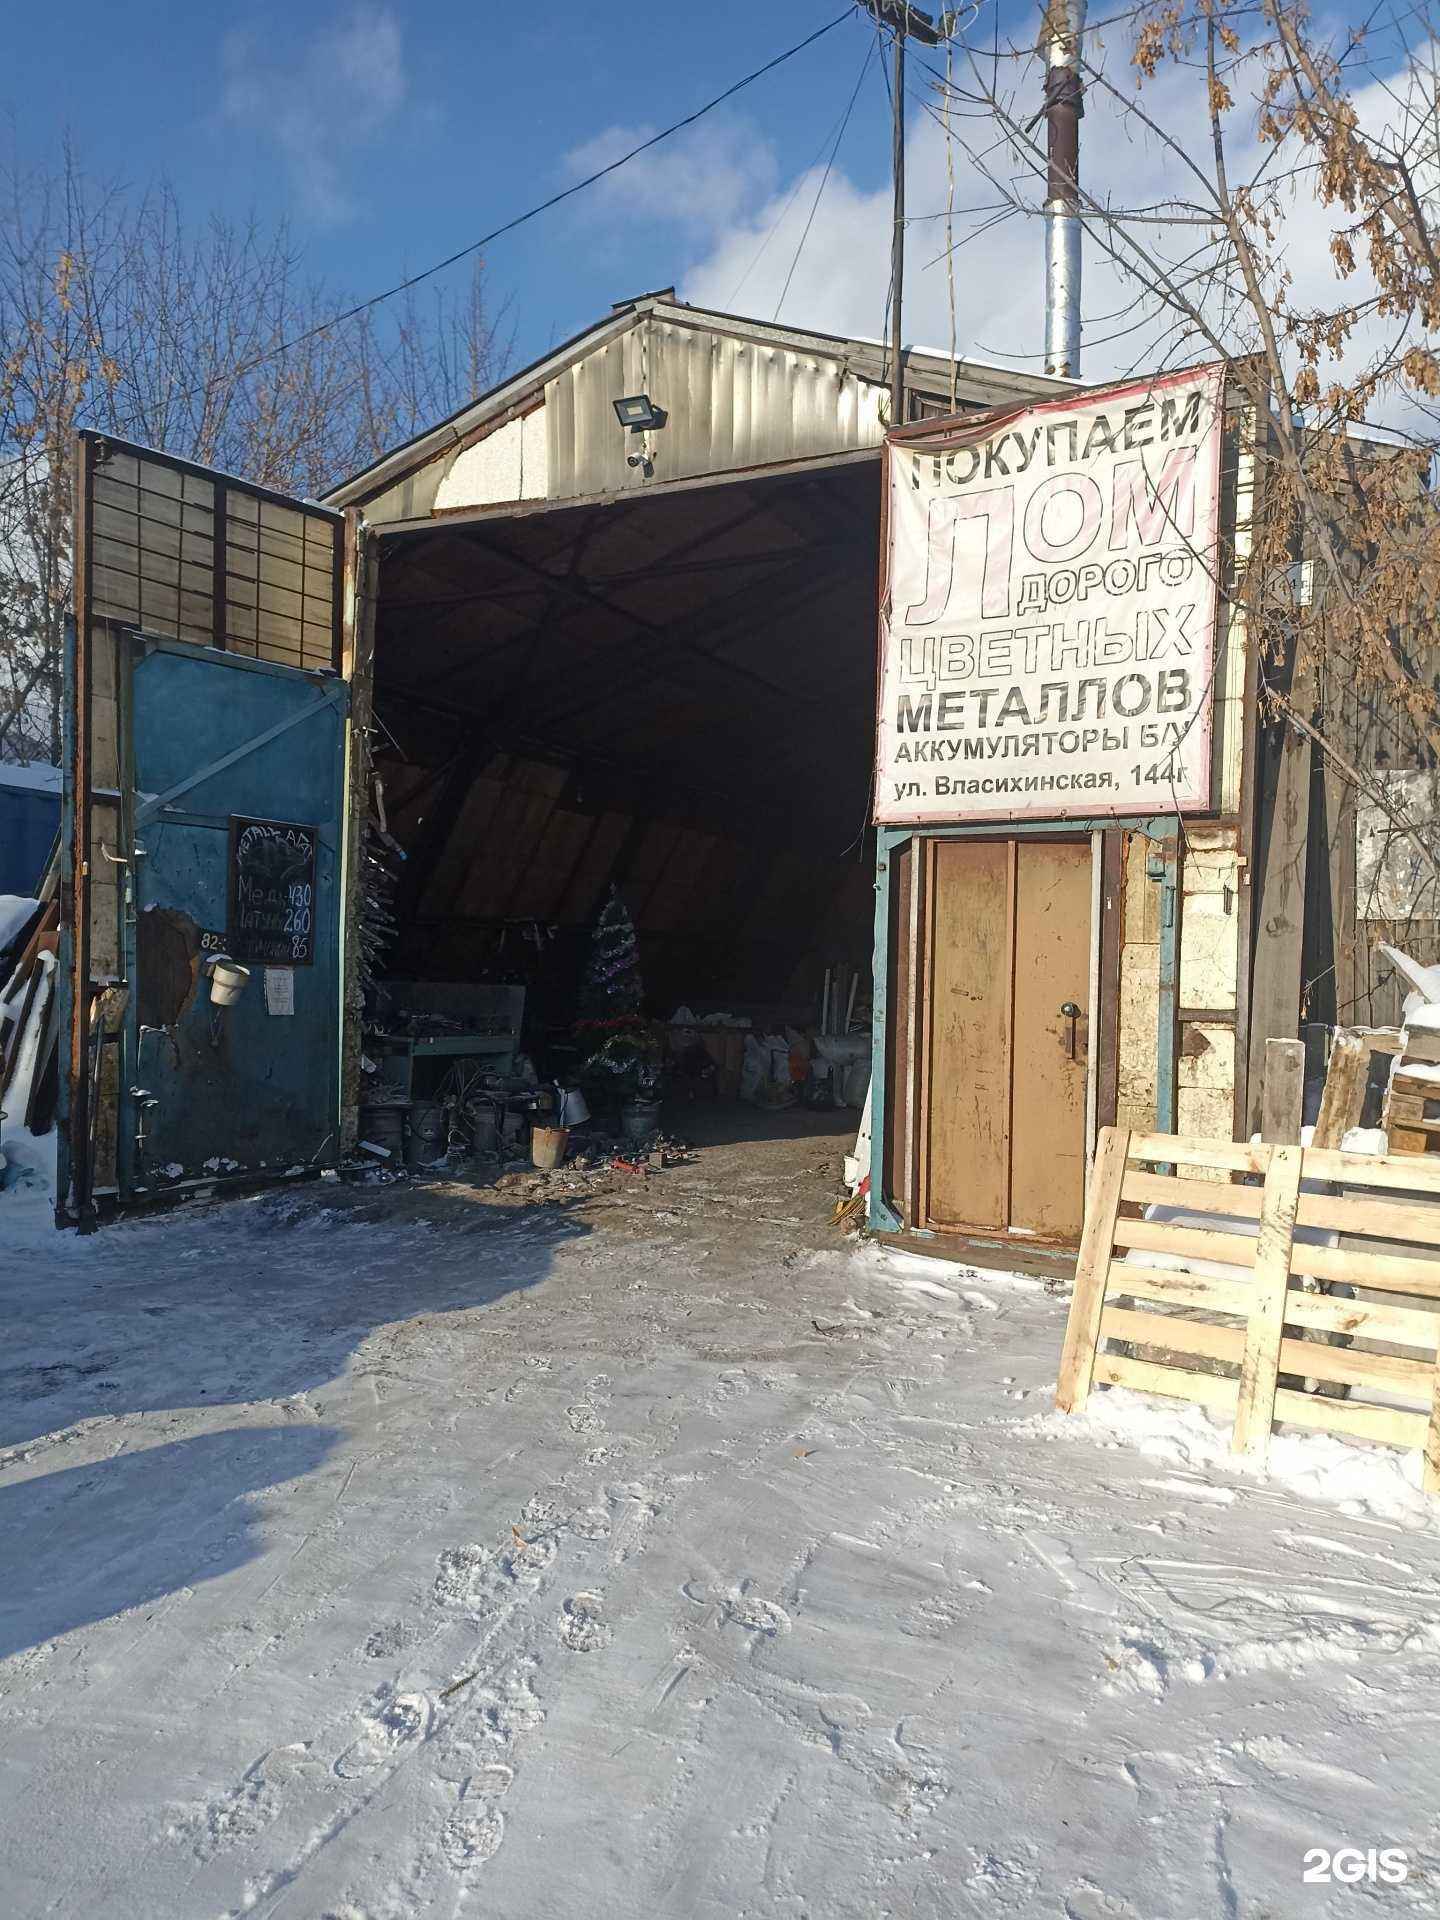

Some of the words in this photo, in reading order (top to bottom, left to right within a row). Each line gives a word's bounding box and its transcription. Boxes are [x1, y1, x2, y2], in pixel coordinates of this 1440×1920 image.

[912, 391, 1200, 490] ПОКУПАЕМ
[905, 444, 1198, 627] ЛОМ
[1017, 548, 1194, 616] ДОРОГО
[899, 604, 1196, 691] ЦВЕТНЫХ
[896, 668, 1193, 734] МЕТАЛЛОВ
[894, 729, 1129, 763] АККУМУЛЯТОРЫ
[1140, 720, 1190, 748] Б/У
[893, 780, 927, 801] ул.
[935, 771, 1121, 796] Власихинская,
[283, 908, 311, 934] 260
[291, 935, 310, 959] 85
